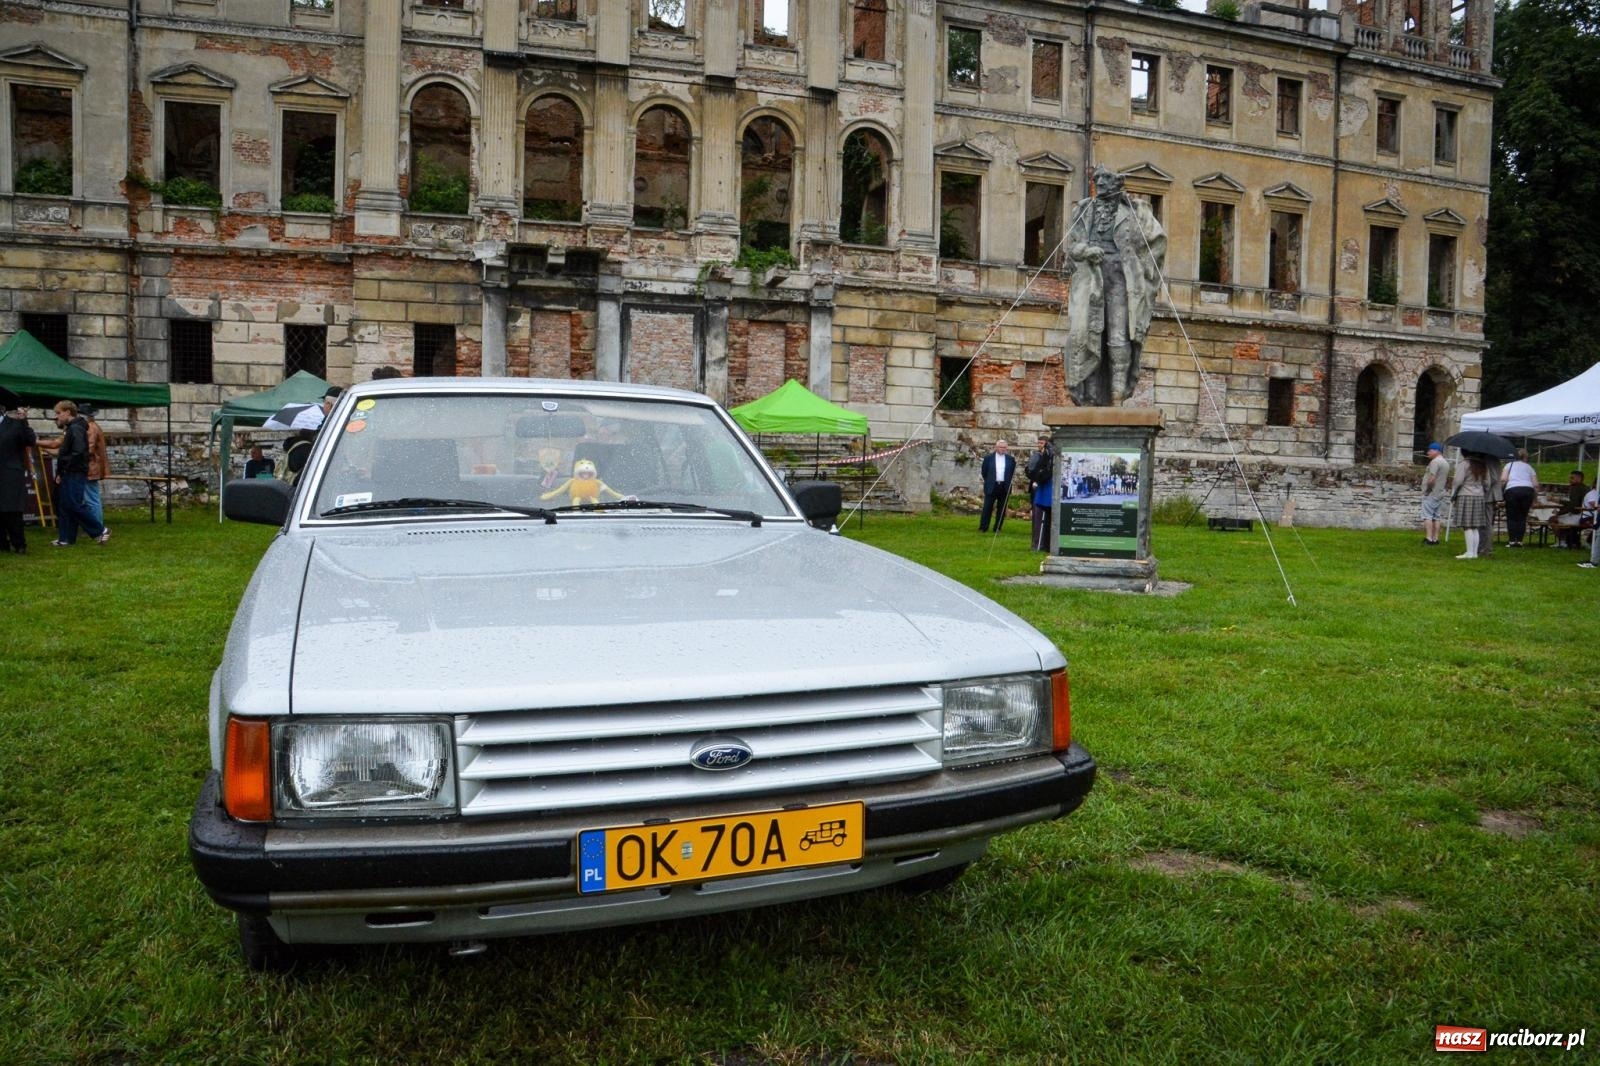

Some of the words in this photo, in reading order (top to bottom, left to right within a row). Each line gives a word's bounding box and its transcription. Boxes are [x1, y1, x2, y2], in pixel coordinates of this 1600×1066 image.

[706, 748, 741, 765] Ford
[616, 829, 678, 881] OK
[700, 818, 786, 872] 70A
[584, 868, 603, 882] PL
